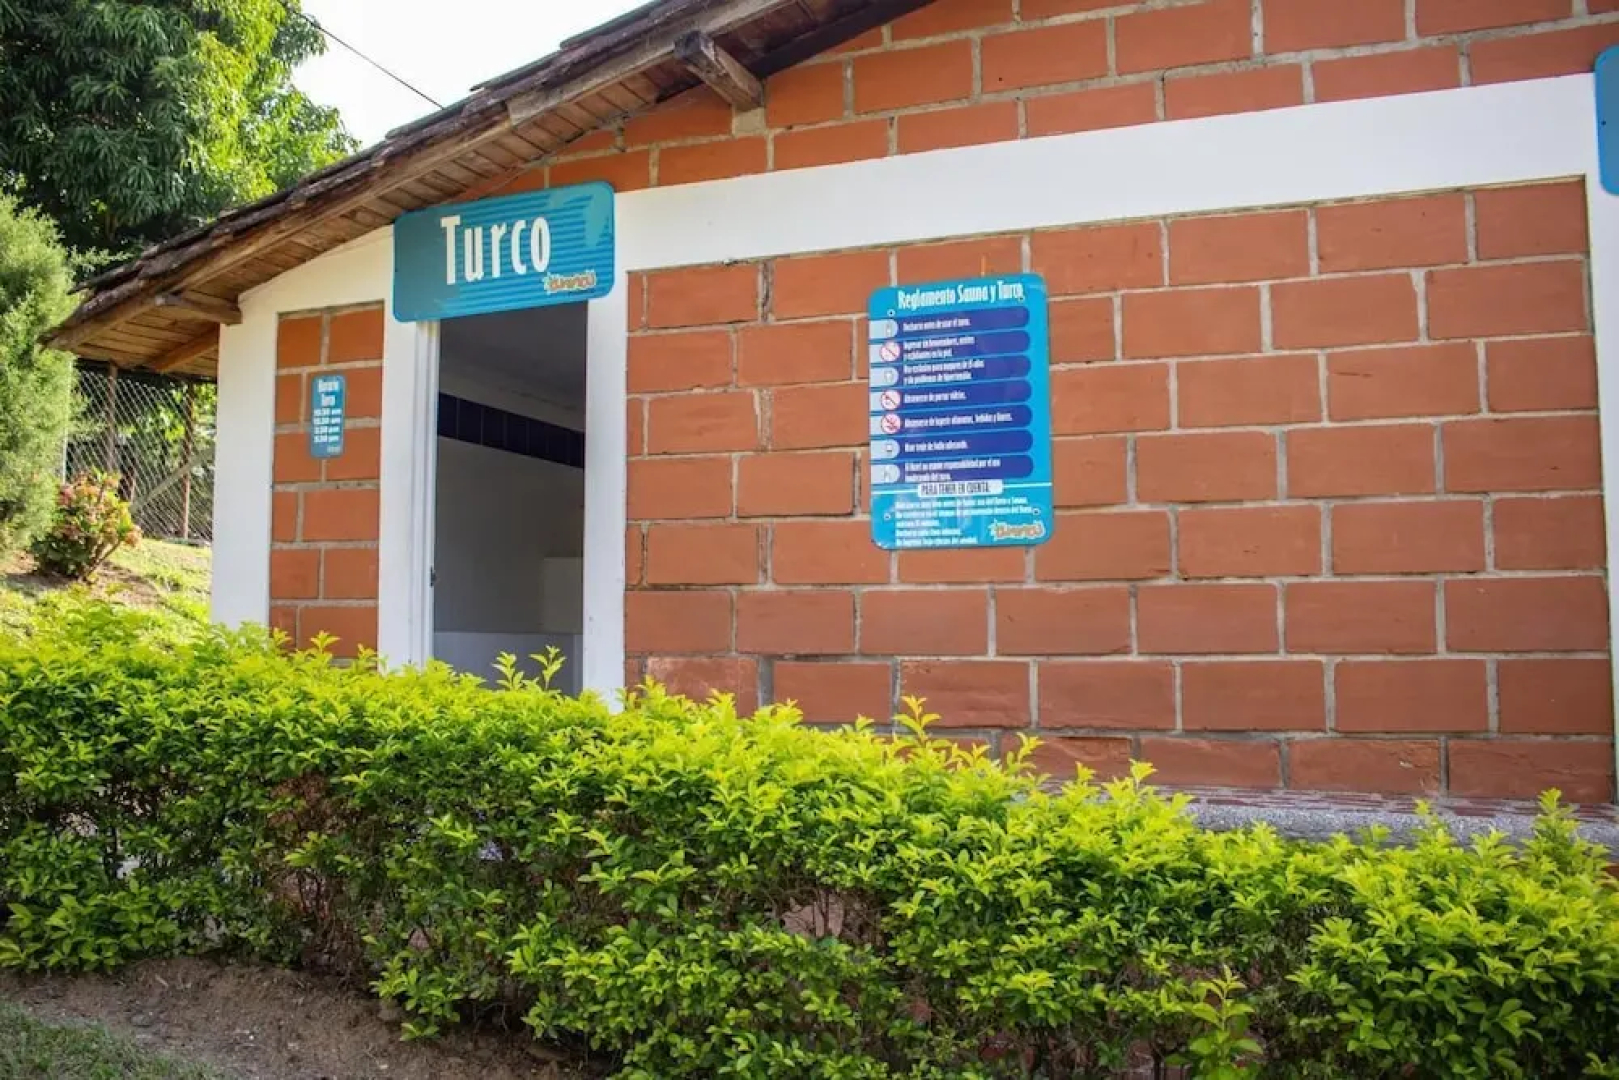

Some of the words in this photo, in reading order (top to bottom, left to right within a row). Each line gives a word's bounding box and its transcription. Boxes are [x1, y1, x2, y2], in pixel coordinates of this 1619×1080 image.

[440, 214, 550, 285] Turco
[898, 287, 955, 310] Reglamento
[957, 284, 988, 303] Sauna
[990, 283, 996, 303] y
